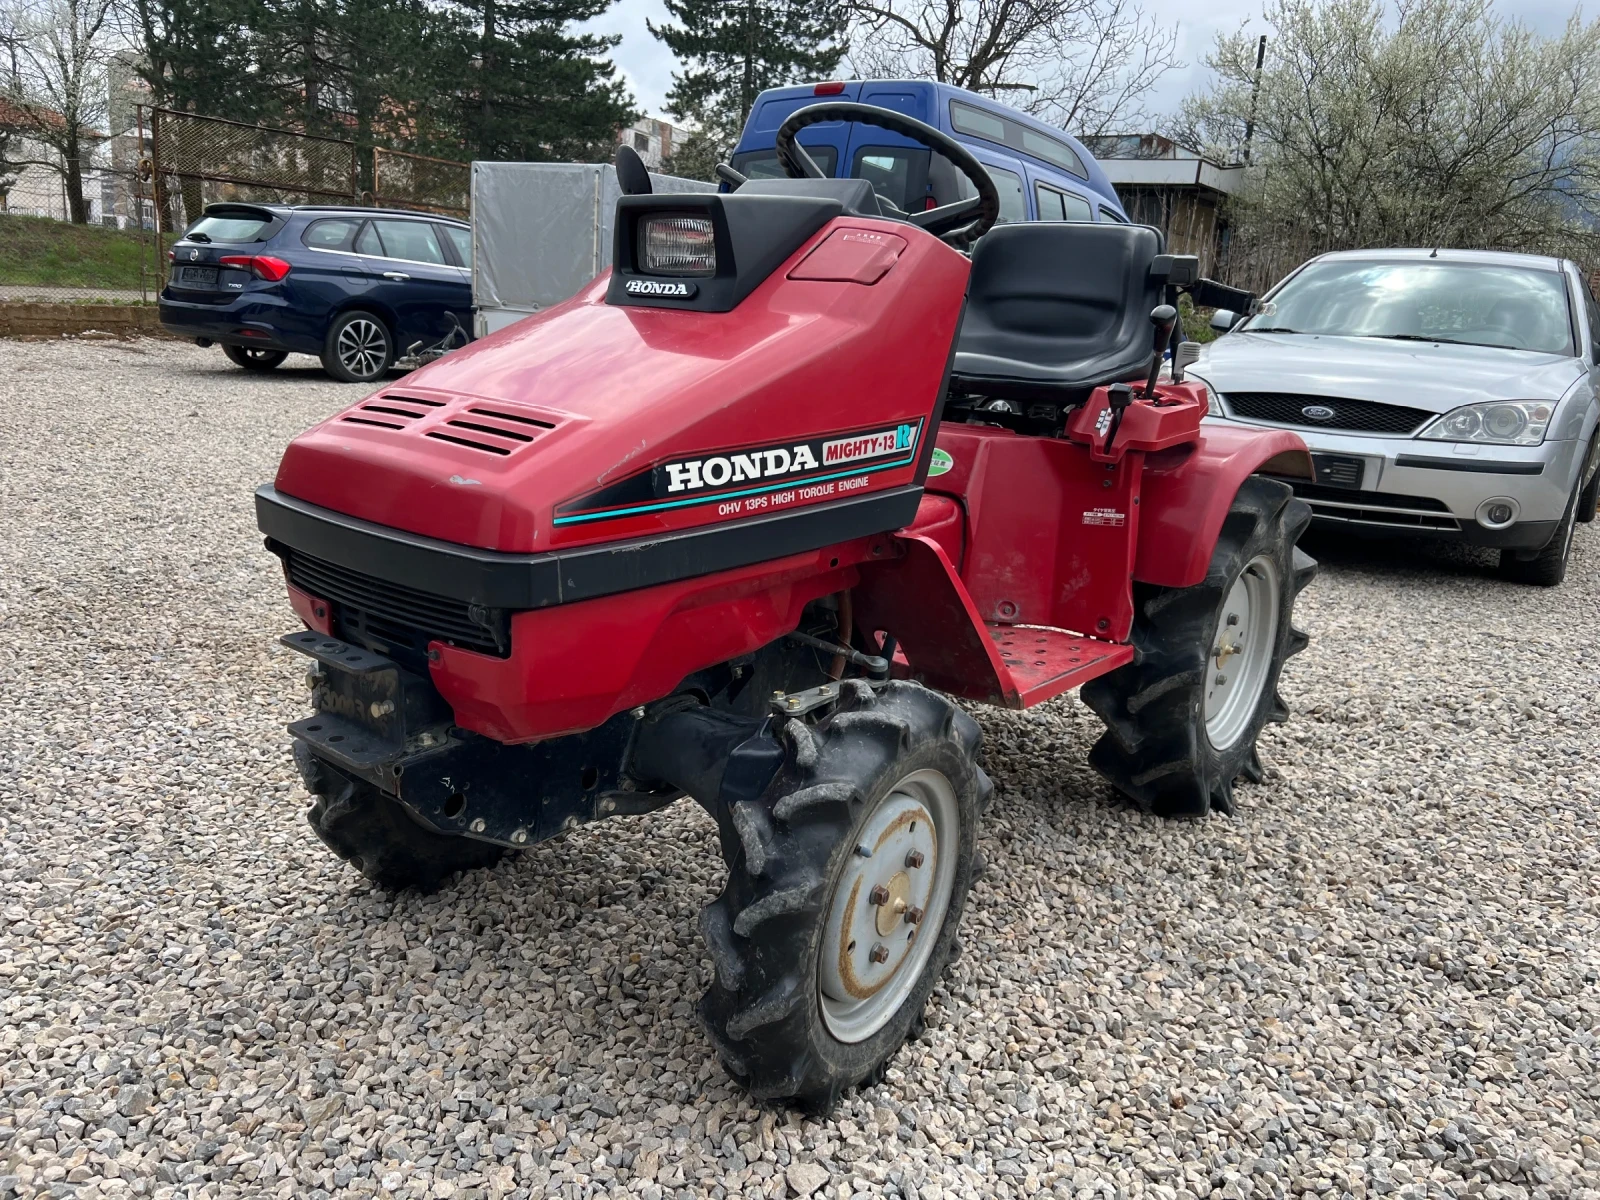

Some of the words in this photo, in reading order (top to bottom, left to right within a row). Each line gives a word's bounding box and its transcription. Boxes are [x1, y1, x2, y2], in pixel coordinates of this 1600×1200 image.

[627, 281, 687, 295] HONDA
[665, 444, 819, 492] HONDA
[718, 501, 742, 515] OHV
[744, 496, 768, 511] 13PS
[771, 491, 795, 506] HIGH
[799, 483, 835, 499] TORQUE
[838, 476, 869, 492] ENGINE
